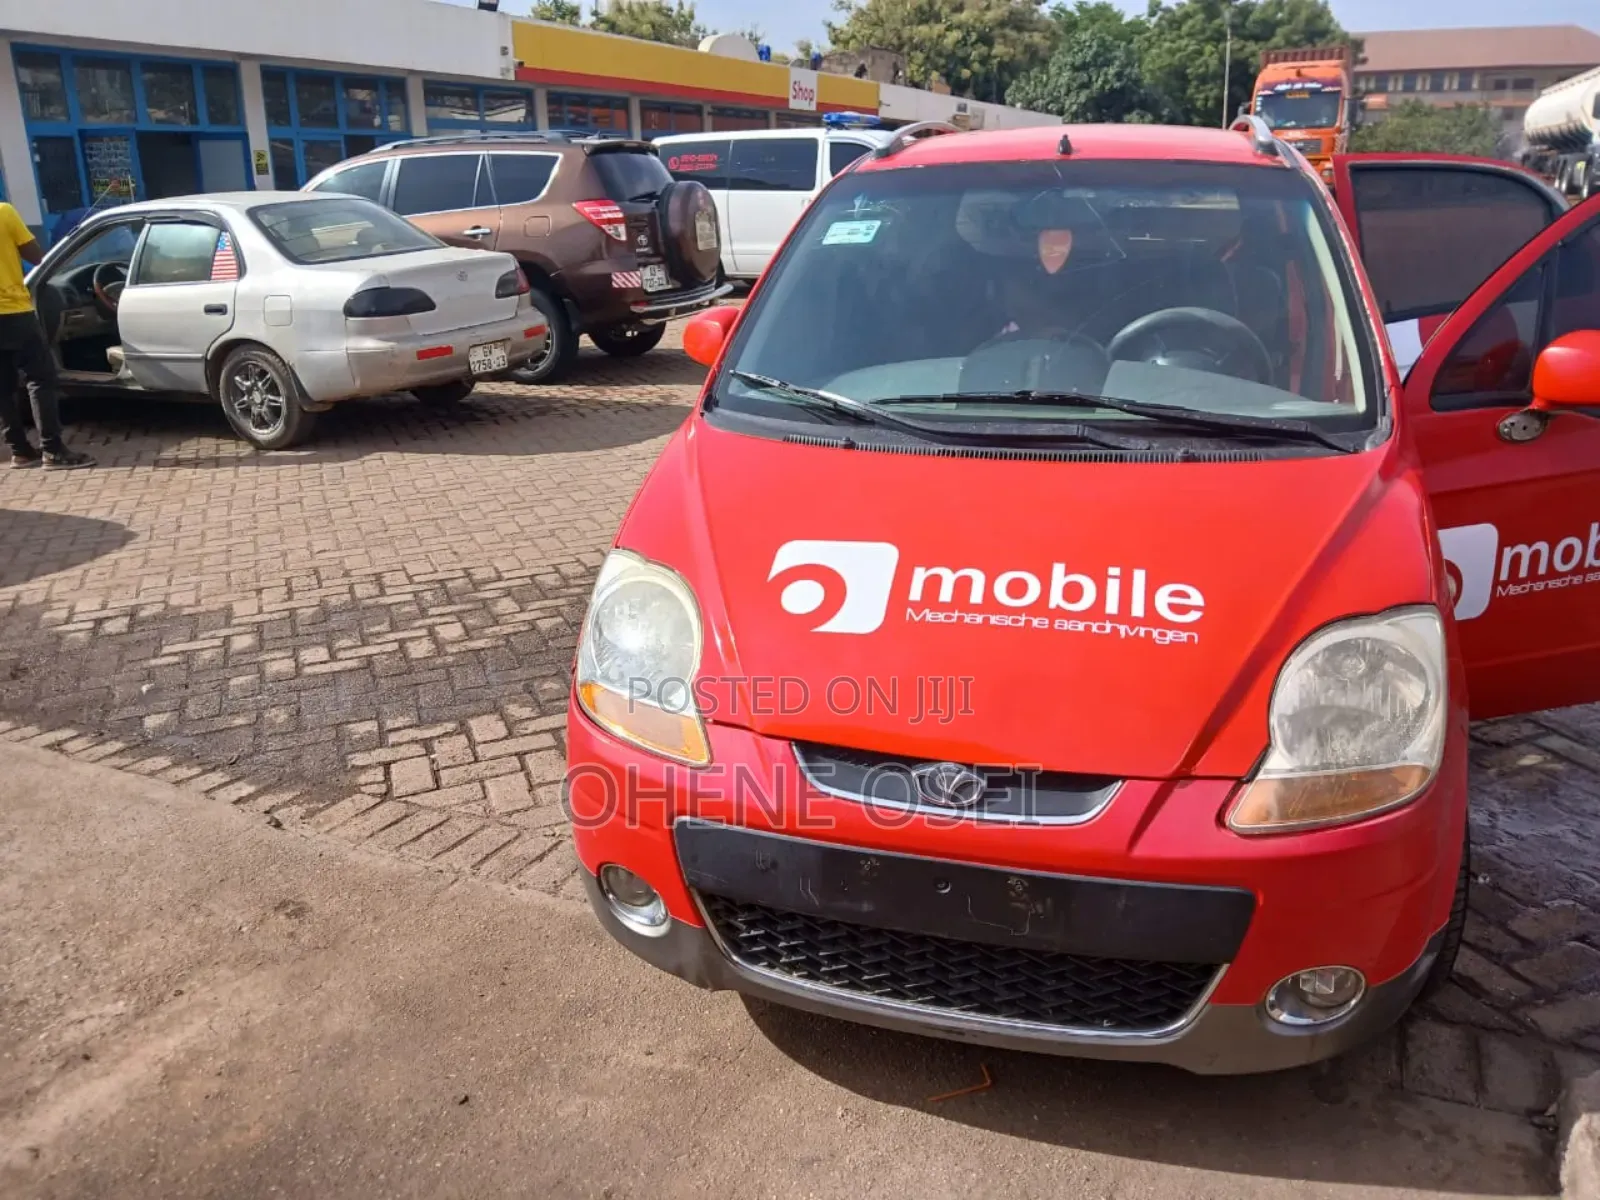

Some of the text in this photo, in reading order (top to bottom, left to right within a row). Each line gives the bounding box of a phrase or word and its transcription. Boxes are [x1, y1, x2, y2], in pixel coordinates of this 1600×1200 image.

[792, 80, 814, 107] Shop
[908, 562, 1205, 623] mobile
[905, 607, 1199, 645] Mechanische aandrijvingen
